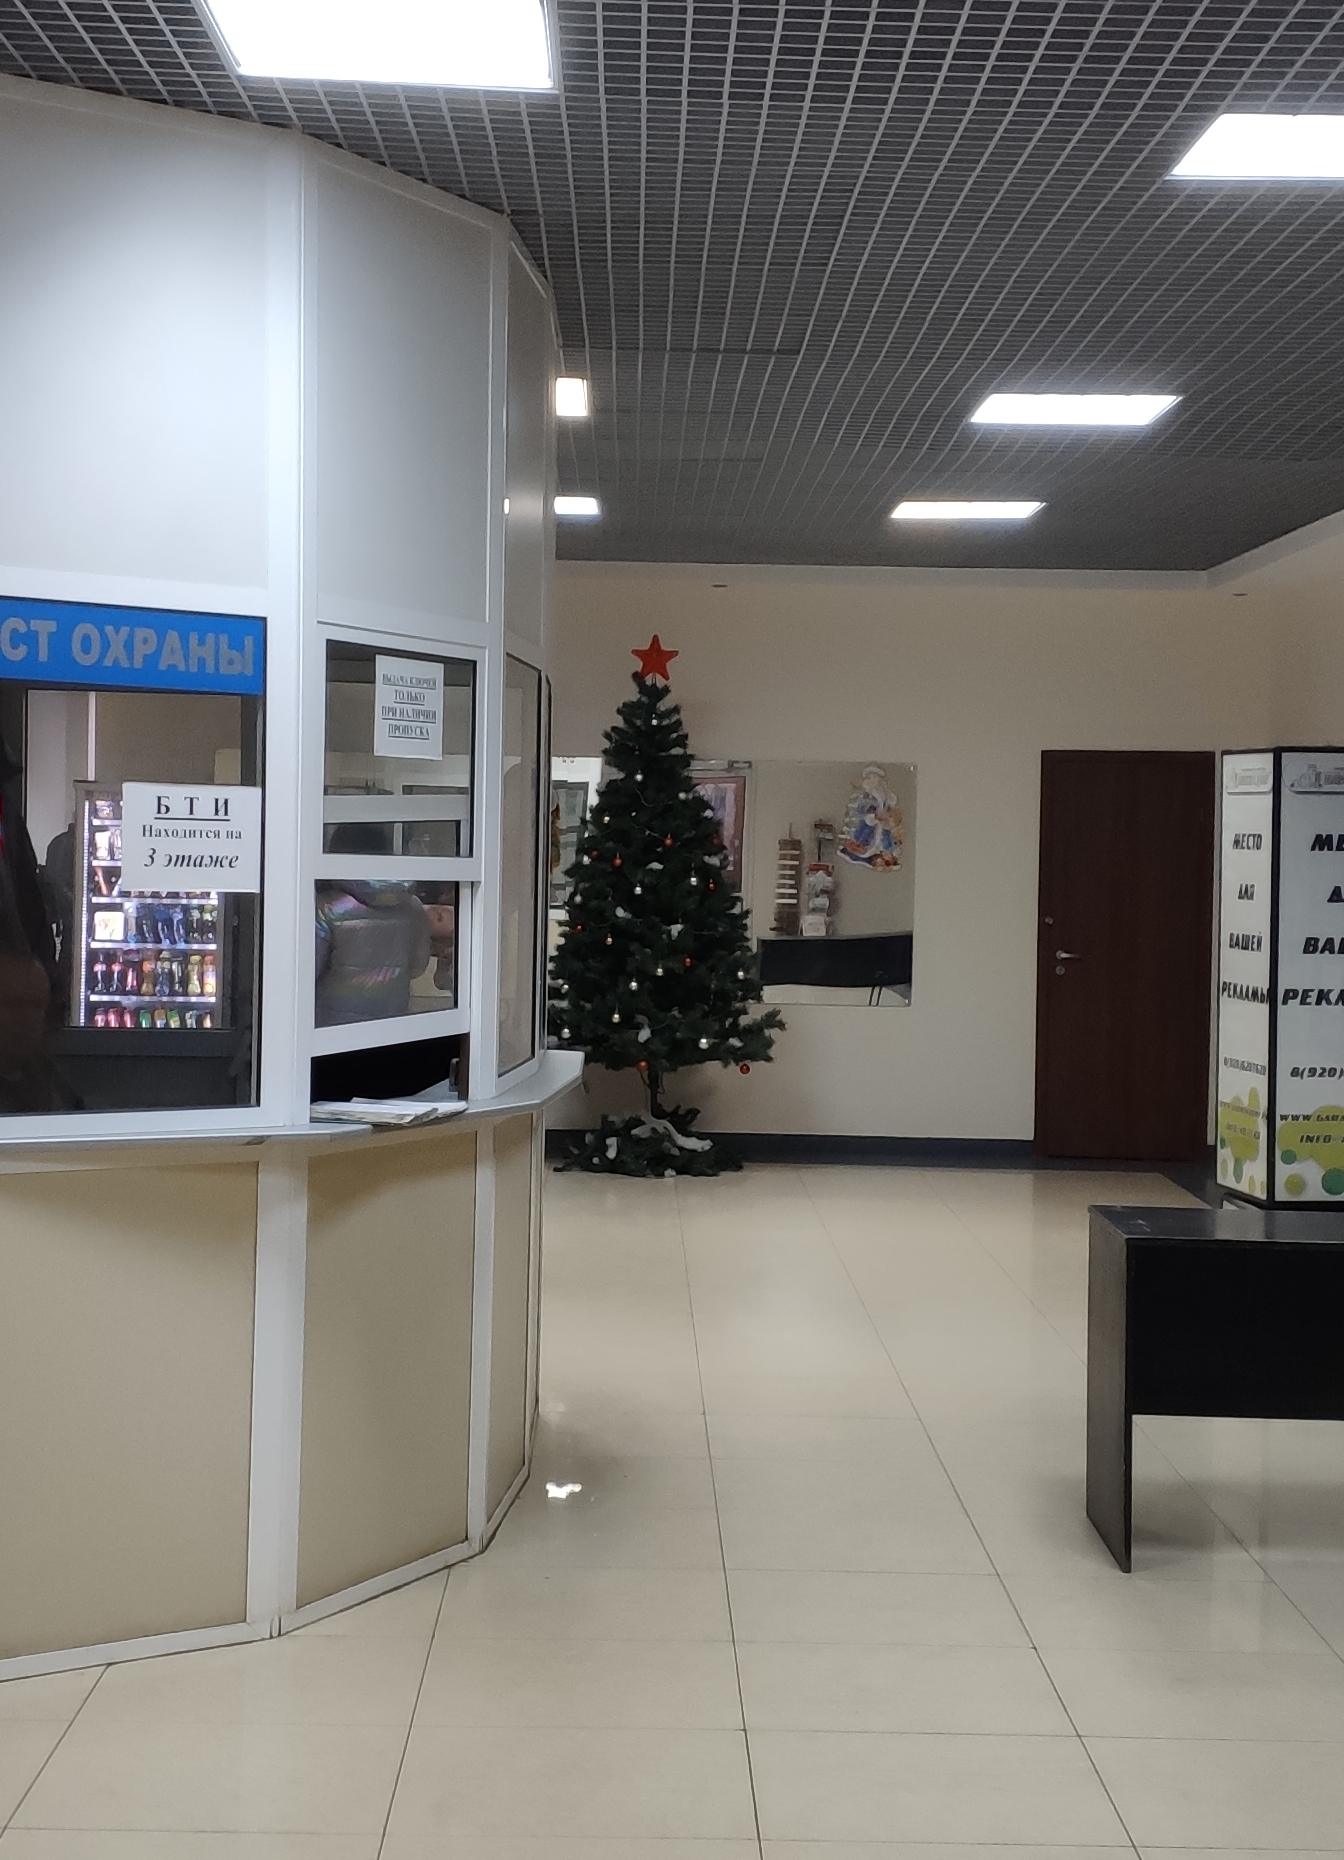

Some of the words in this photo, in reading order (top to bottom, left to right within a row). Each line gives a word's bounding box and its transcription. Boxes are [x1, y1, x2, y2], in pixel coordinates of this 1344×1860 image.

[71, 622, 254, 676] ОХРАНЫ
[394, 689, 425, 703] ТОЛЬКО
[381, 705, 397, 717] ПРИ
[399, 707, 436, 720] НАЛИЧИИ
[388, 723, 429, 737] ПРОПУСКА
[141, 824, 221, 841] Находится
[226, 828, 243, 840] на
[1232, 833, 1263, 850] МЕСТО
[143, 847, 157, 868] 3
[161, 853, 240, 869] этаже
[1237, 883, 1255, 901] ДЛЯ
[1229, 931, 1263, 953] ВАШЕЙ
[1222, 980, 1271, 1005] РЕКЛАМЫ
